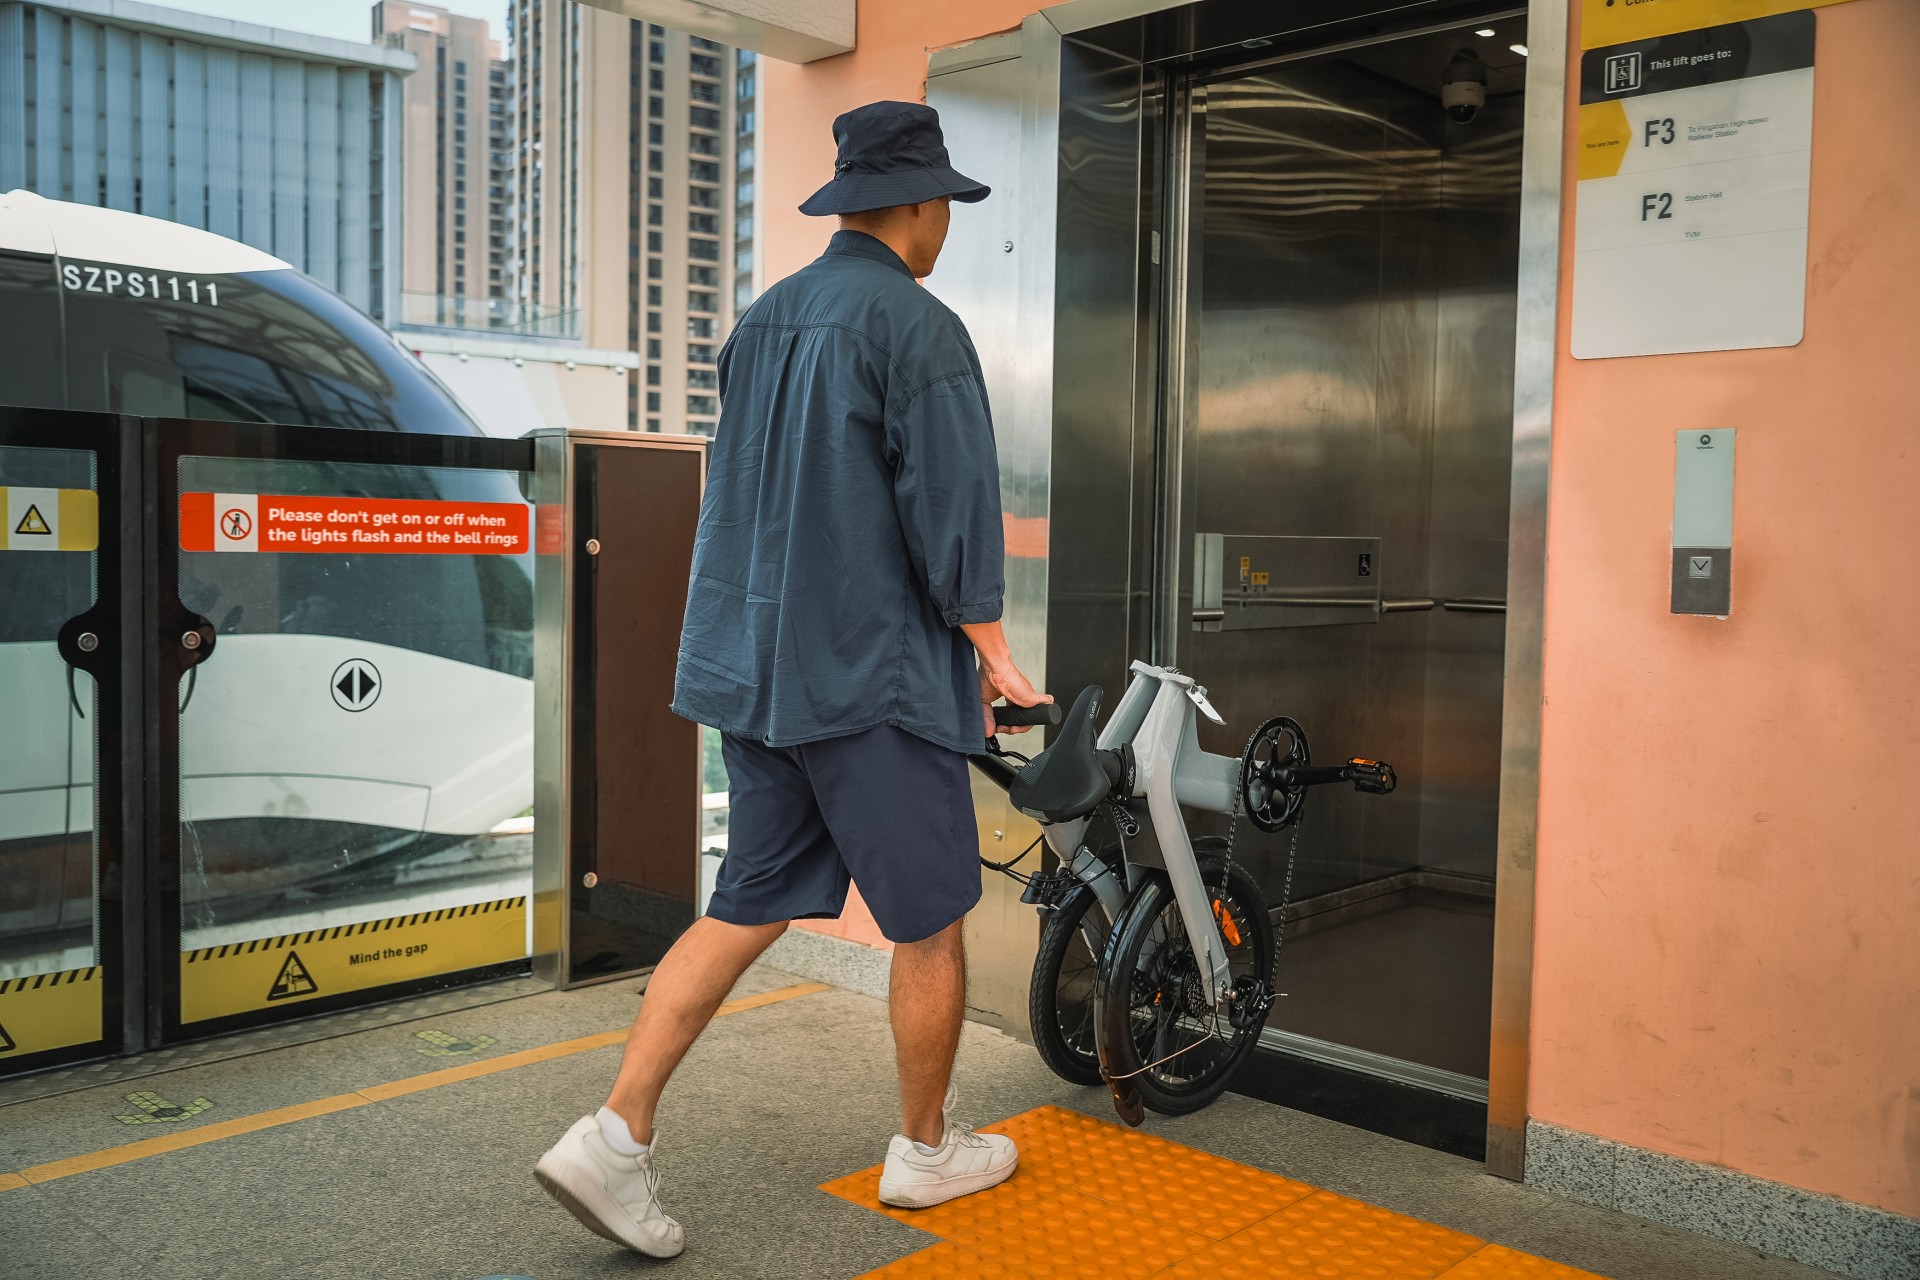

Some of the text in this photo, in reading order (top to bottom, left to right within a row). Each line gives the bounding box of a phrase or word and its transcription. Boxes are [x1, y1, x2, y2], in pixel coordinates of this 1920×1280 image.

[1650, 50, 1731, 70] This lift goes to:
[1644, 117, 1675, 147] F3
[1642, 192, 1672, 221] F2
[63, 264, 218, 306] SZPS1111
[269, 508, 506, 527] Please don't get on or off when
[268, 528, 518, 547] the lights flash and the bell rings
[349, 943, 428, 965] Mind the gap
